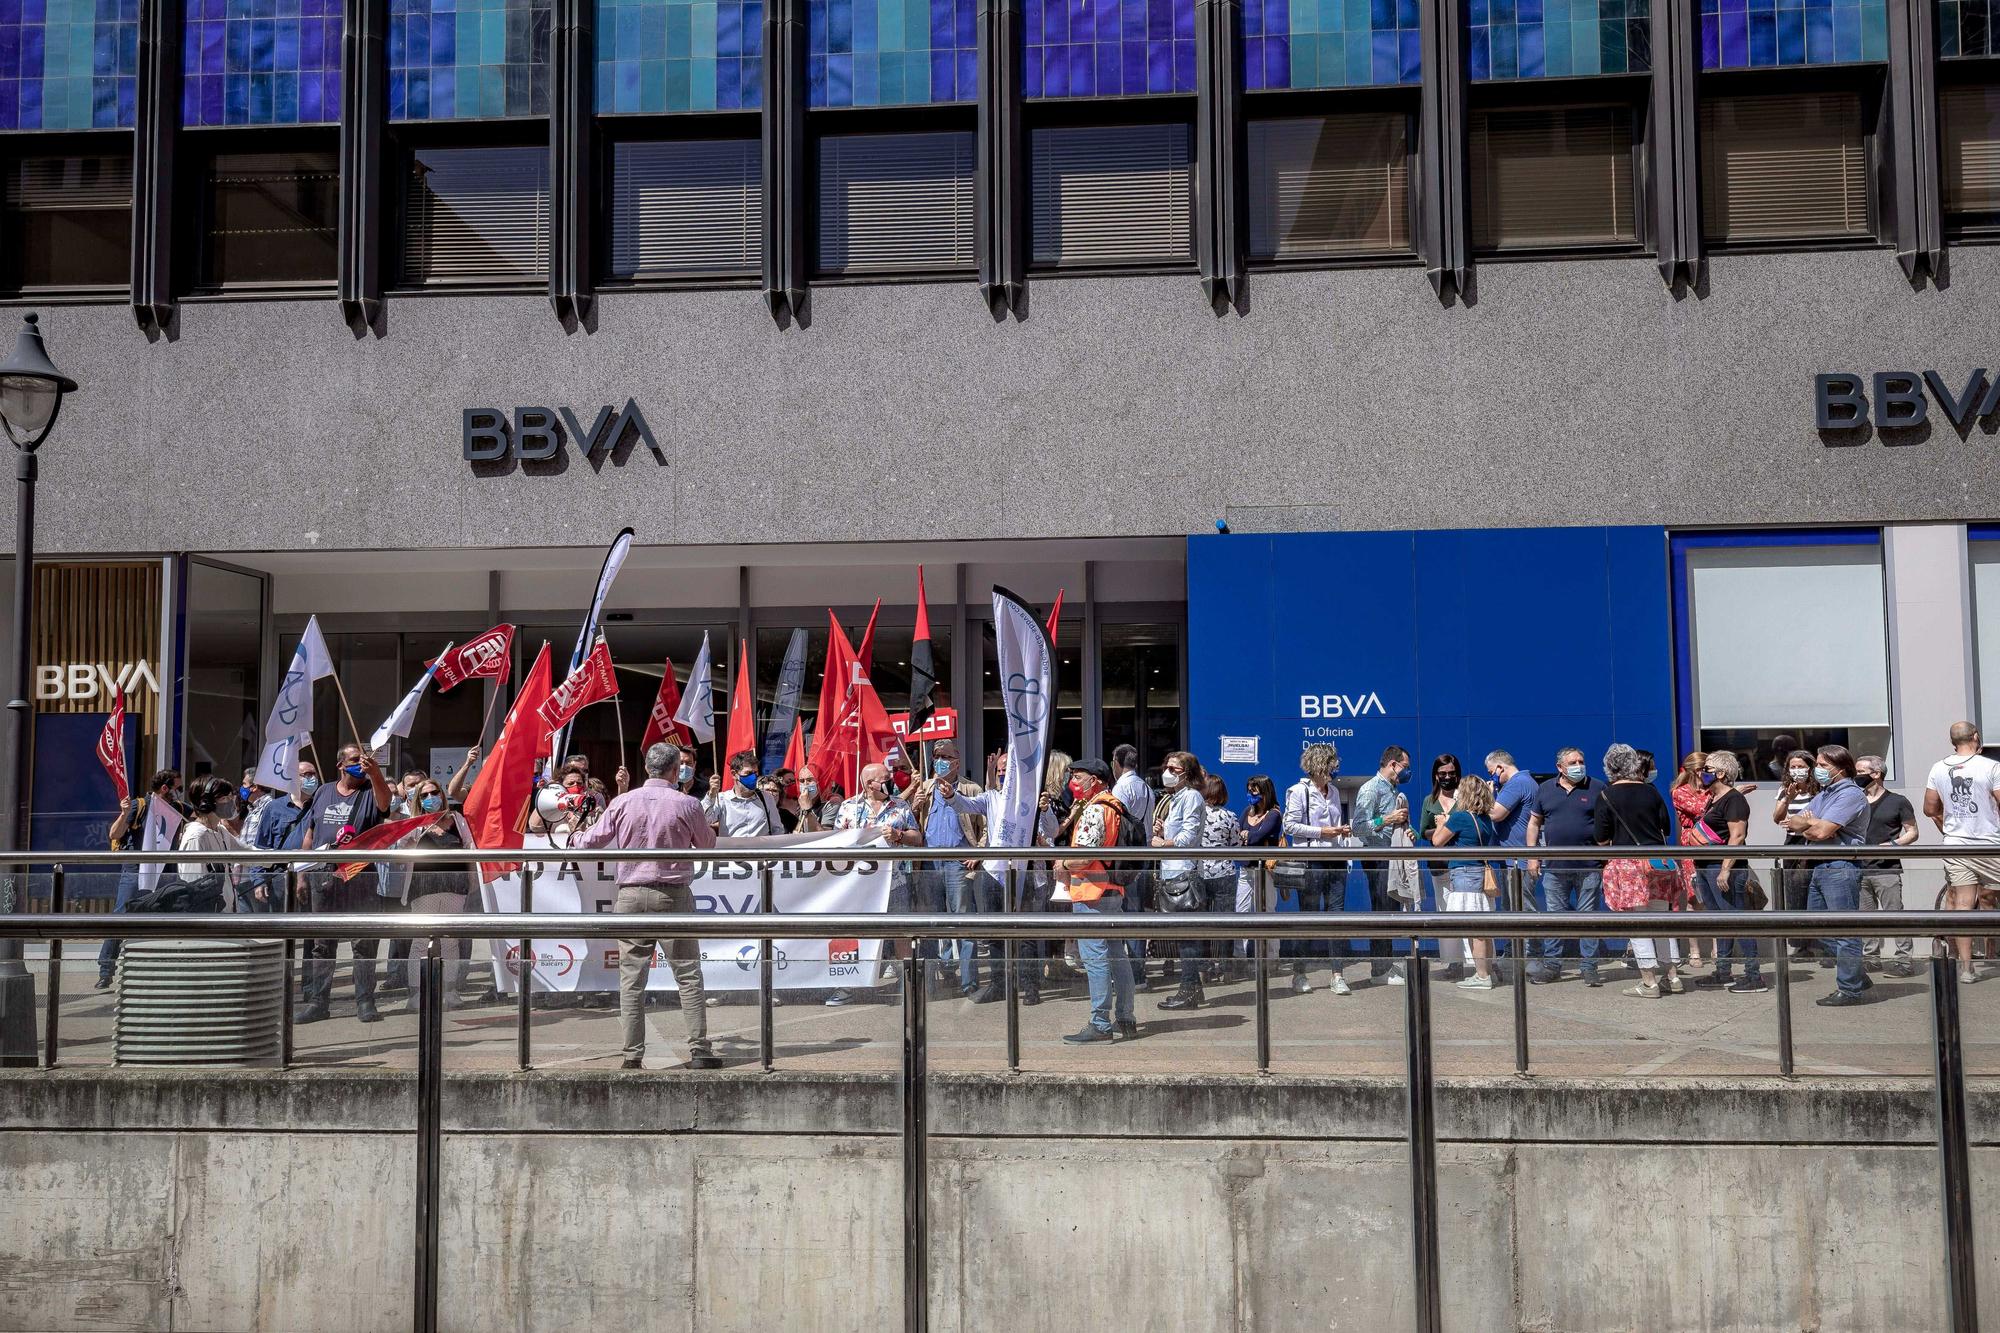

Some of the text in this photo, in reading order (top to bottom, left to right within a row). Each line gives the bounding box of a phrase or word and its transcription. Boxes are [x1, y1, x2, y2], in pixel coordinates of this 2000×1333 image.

[463, 397, 659, 461] BBVA
[36, 659, 161, 700] BBVA
[1300, 691, 1387, 718] BBVA
[1302, 726, 1354, 738] Tu Oficina
[831, 951, 858, 961] CGT
[829, 966, 860, 977] BBVA
